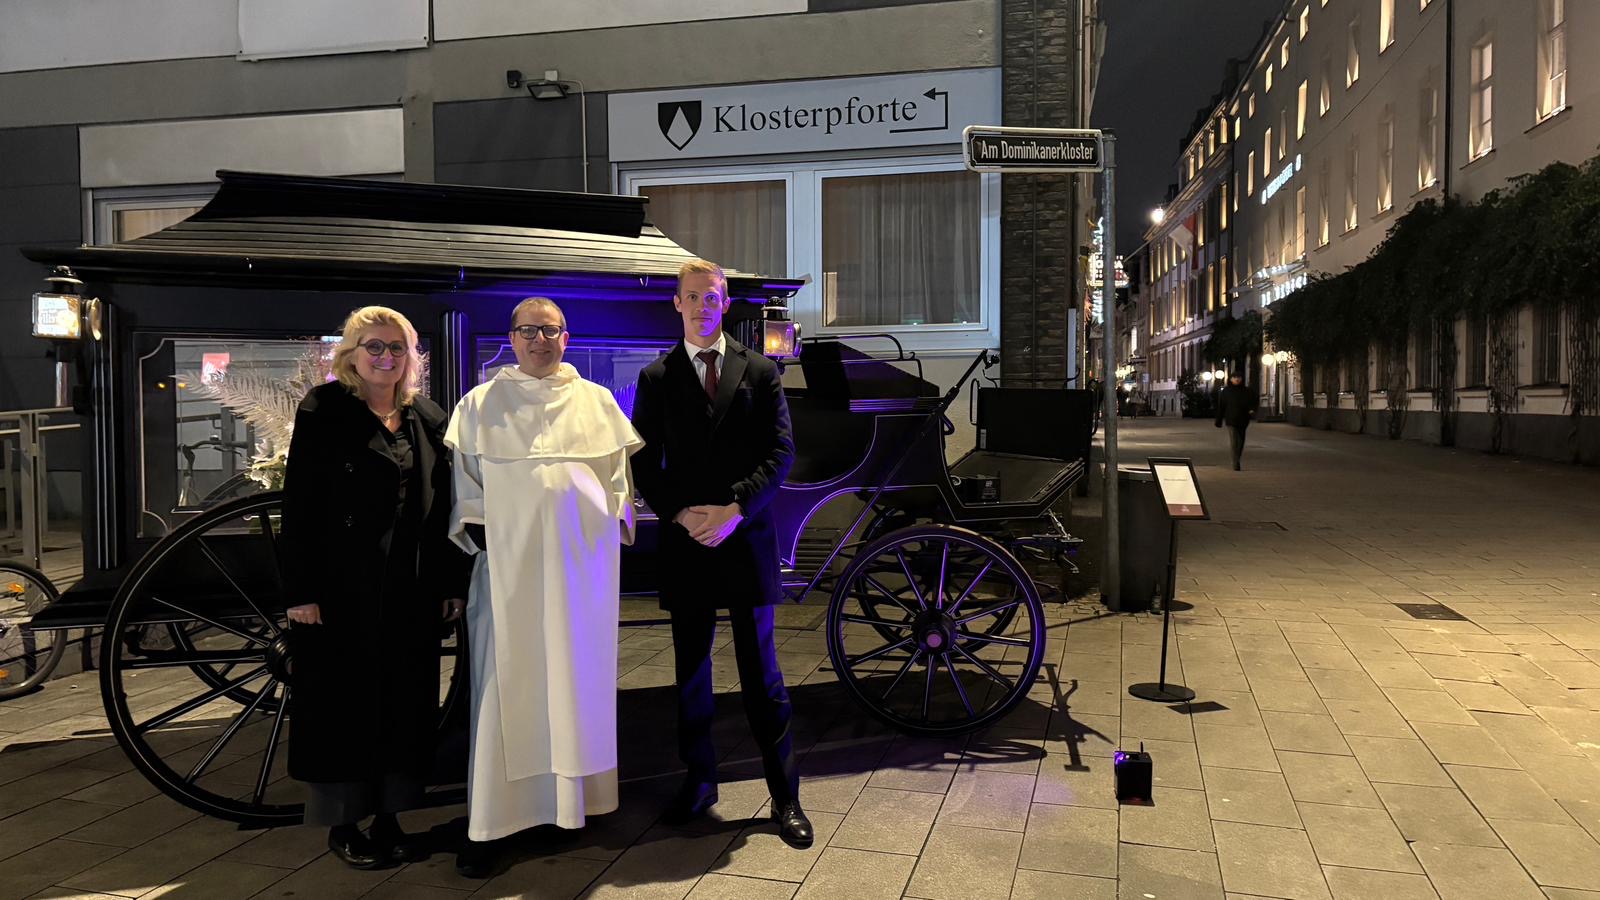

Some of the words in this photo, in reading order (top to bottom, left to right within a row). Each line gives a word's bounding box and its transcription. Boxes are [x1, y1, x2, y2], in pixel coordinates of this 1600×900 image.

[713, 96, 917, 135] Klosterpforte
[981, 140, 999, 159] Am
[1001, 140, 1094, 160] Dominikanerkloster
